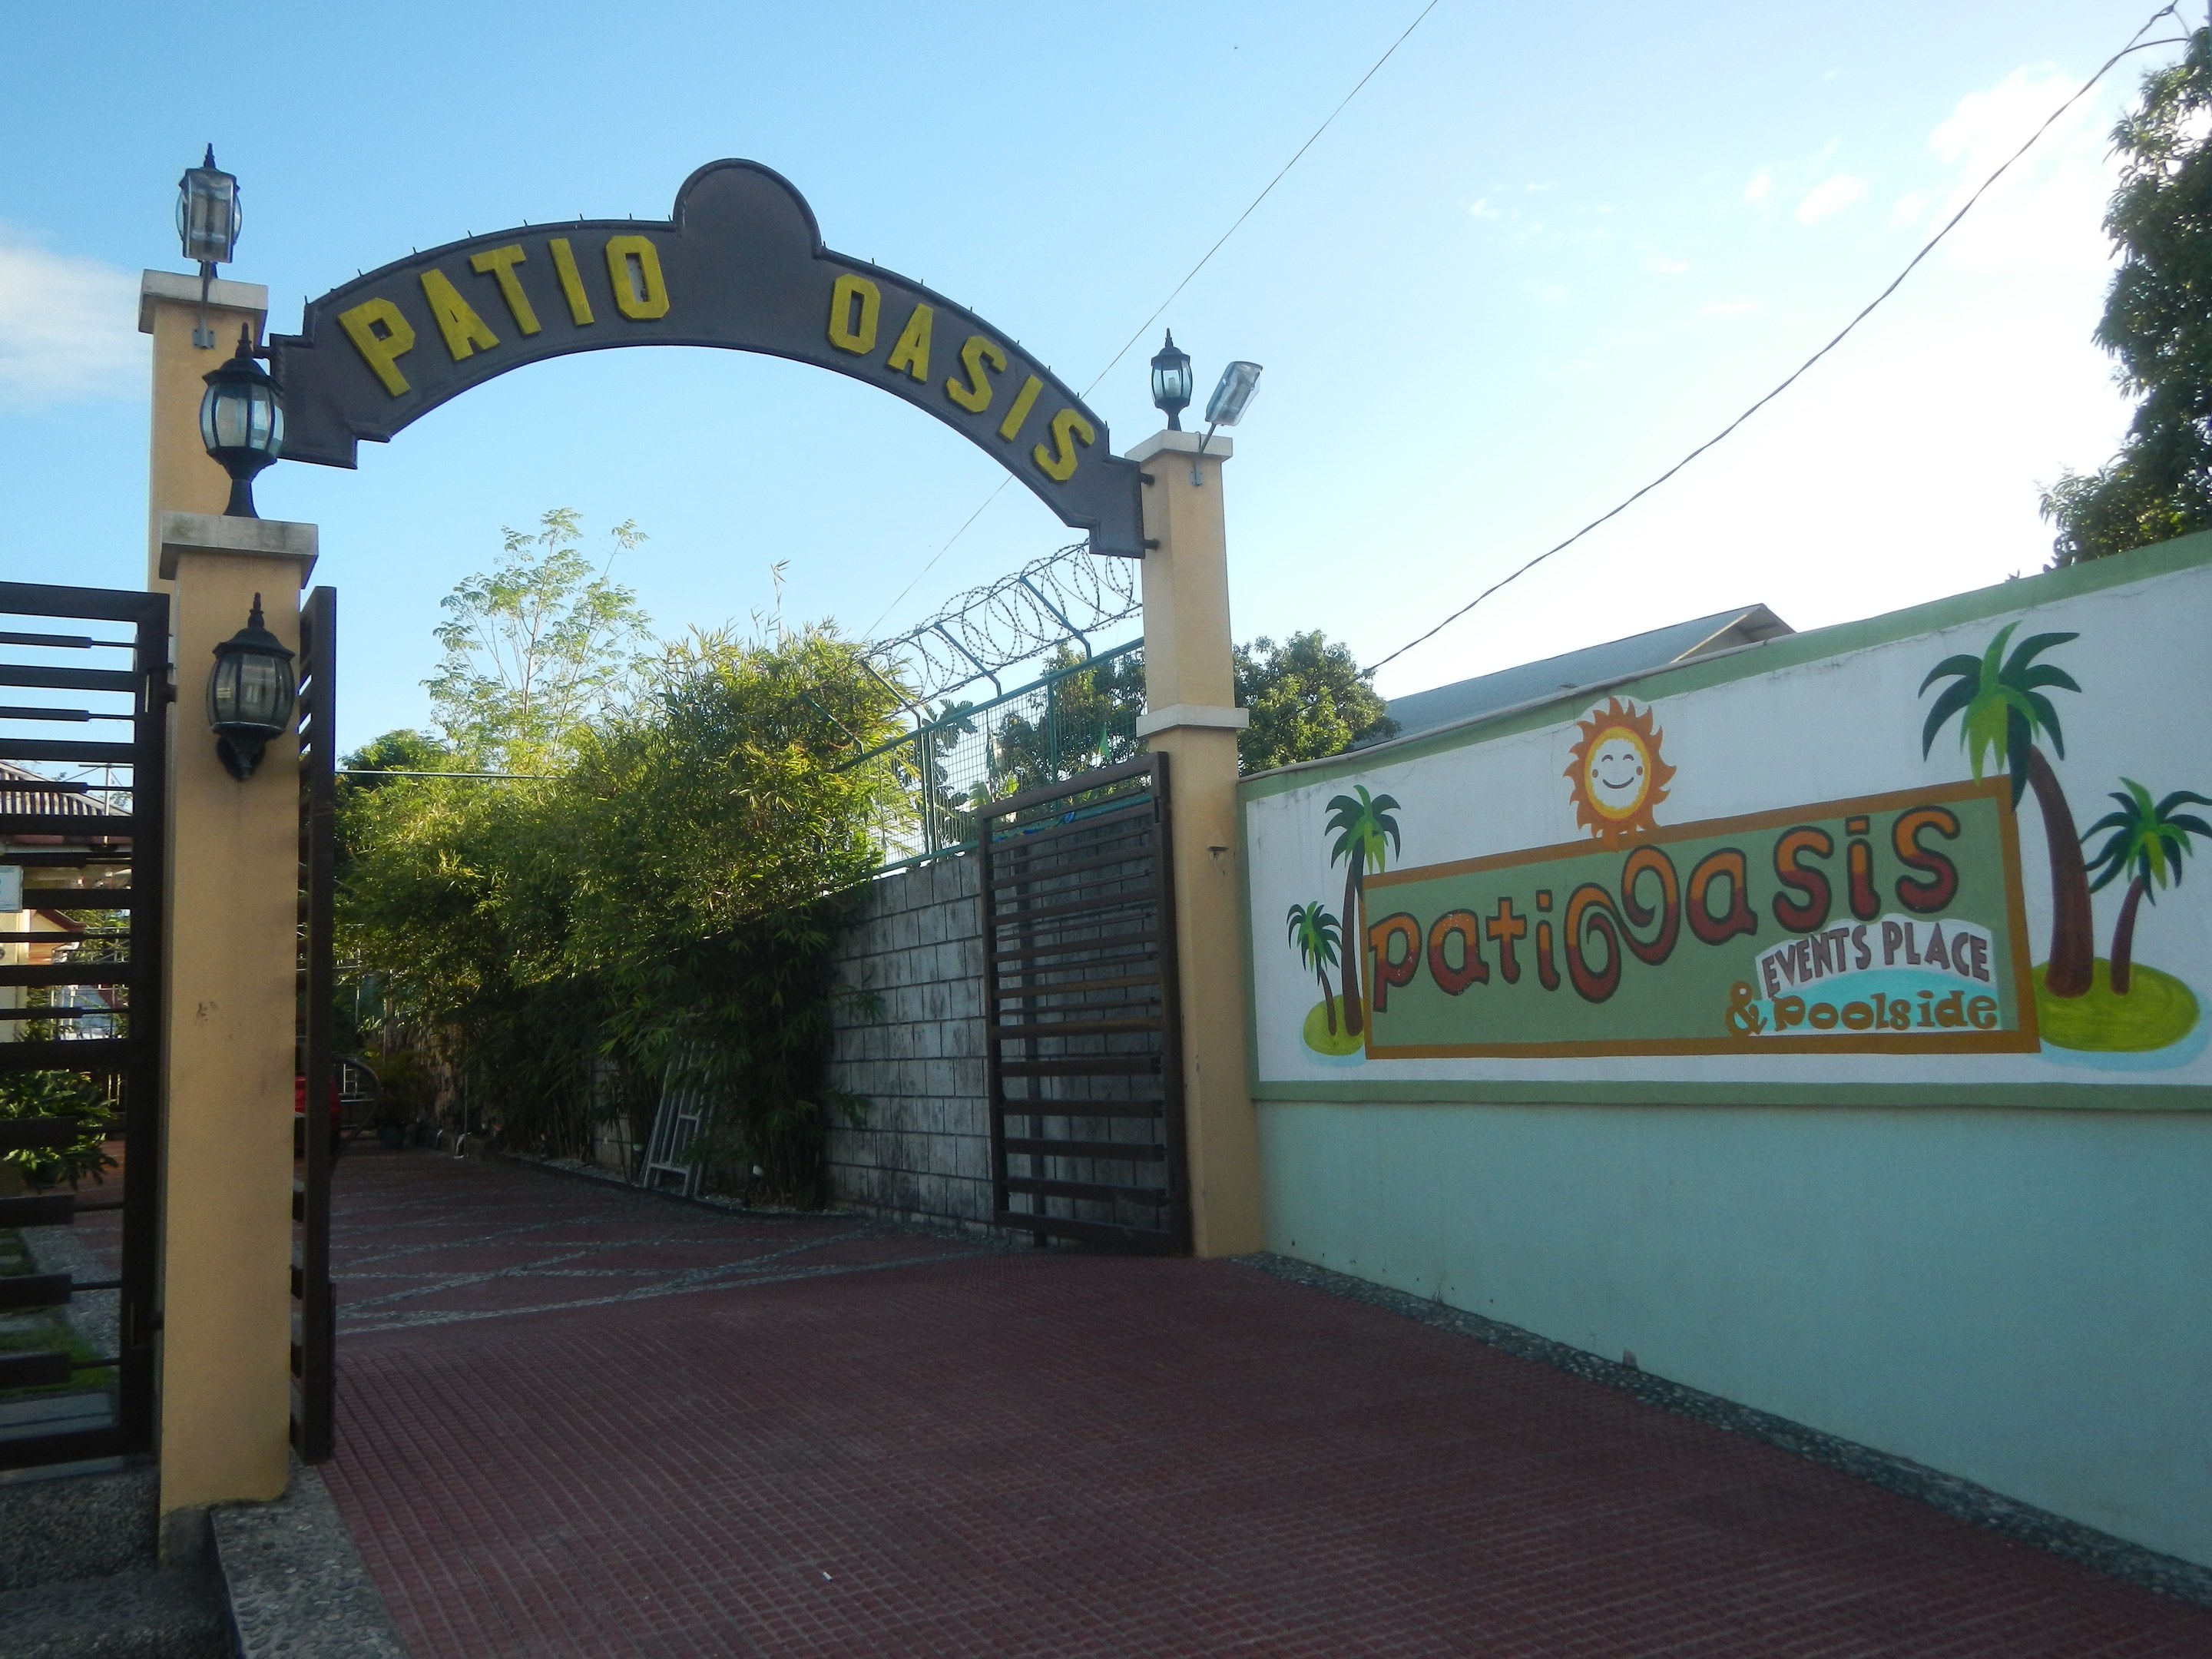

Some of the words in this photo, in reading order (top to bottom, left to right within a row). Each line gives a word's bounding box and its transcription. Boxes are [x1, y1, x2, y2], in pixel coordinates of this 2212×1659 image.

[338, 234, 670, 397] PATIO
[828, 273, 1096, 482] OASIS
[1762, 925, 1872, 998] EVENTS
[1881, 921, 1990, 982] PLACE
[1725, 981, 1767, 1037] &
